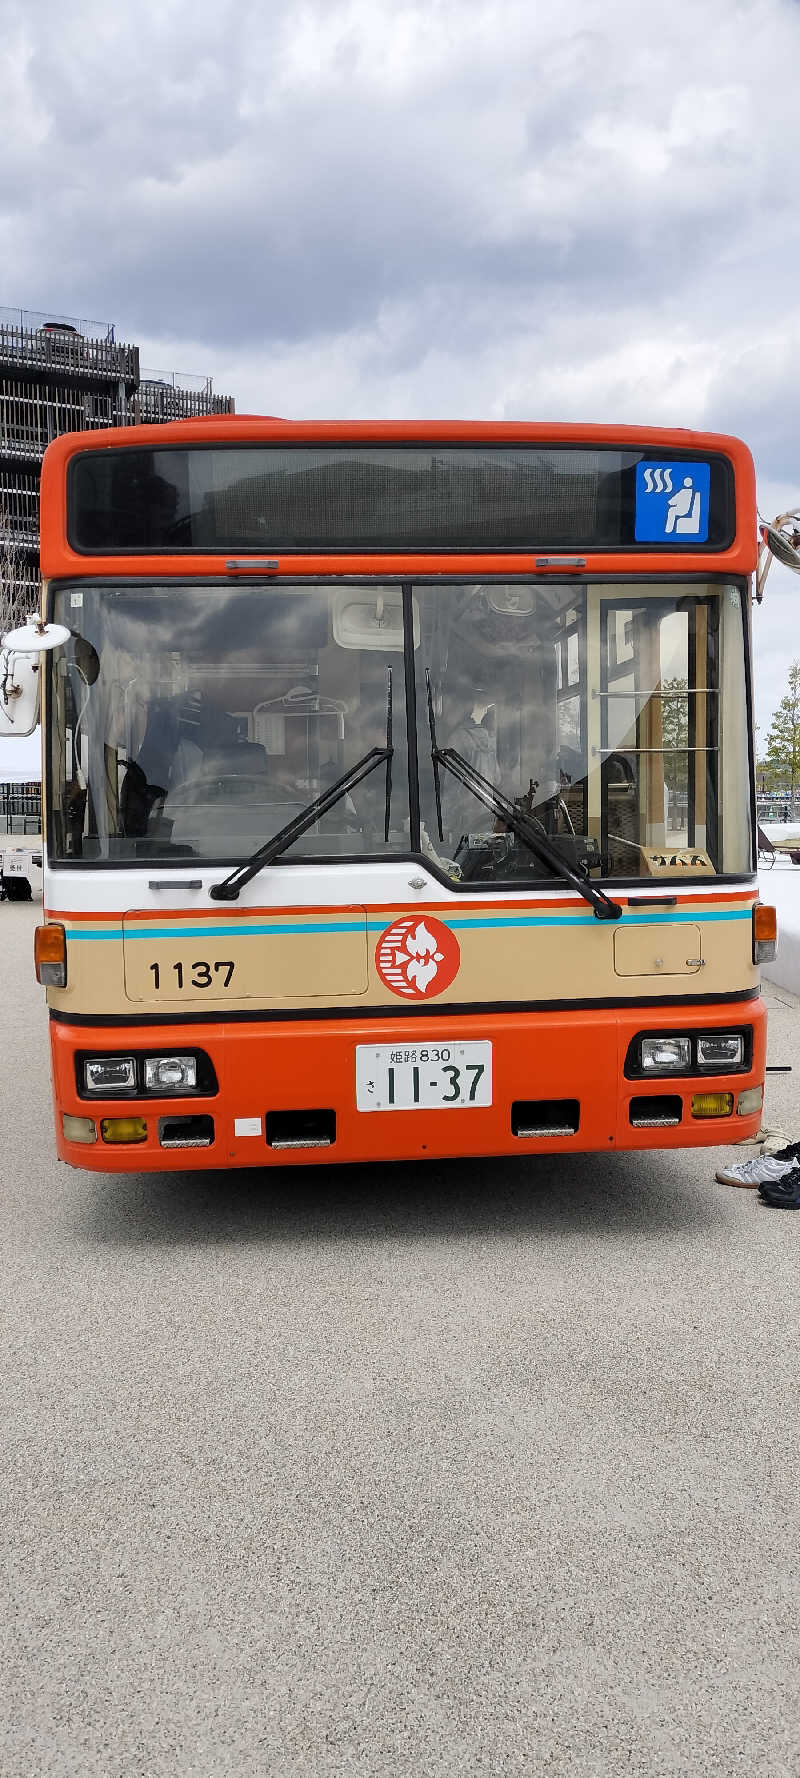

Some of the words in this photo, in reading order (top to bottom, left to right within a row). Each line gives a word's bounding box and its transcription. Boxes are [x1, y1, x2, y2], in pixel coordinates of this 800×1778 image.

[150, 961, 235, 989] 1137
[365, 1080, 375, 1094] さ
[388, 1064, 485, 1105] 11-37
